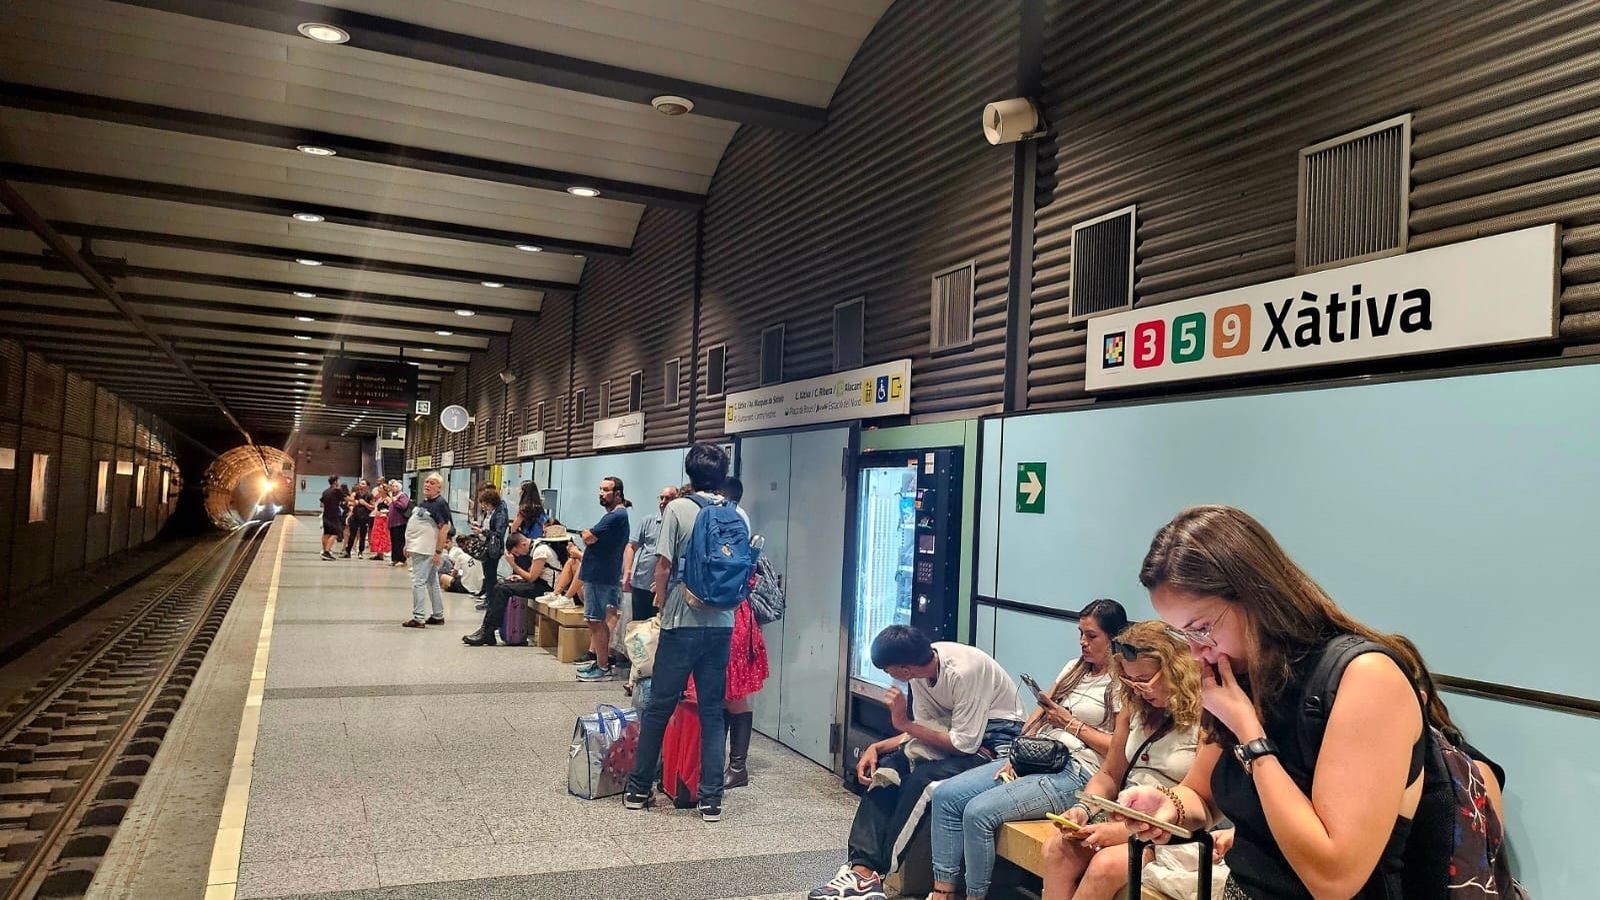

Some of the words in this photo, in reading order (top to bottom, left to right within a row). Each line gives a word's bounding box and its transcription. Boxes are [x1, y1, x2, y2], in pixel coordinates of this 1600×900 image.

[1141, 329, 1157, 362] 3
[1180, 321, 1198, 356] 5
[1222, 314, 1241, 349] 9
[1262, 283, 1433, 352] Xàtiva
